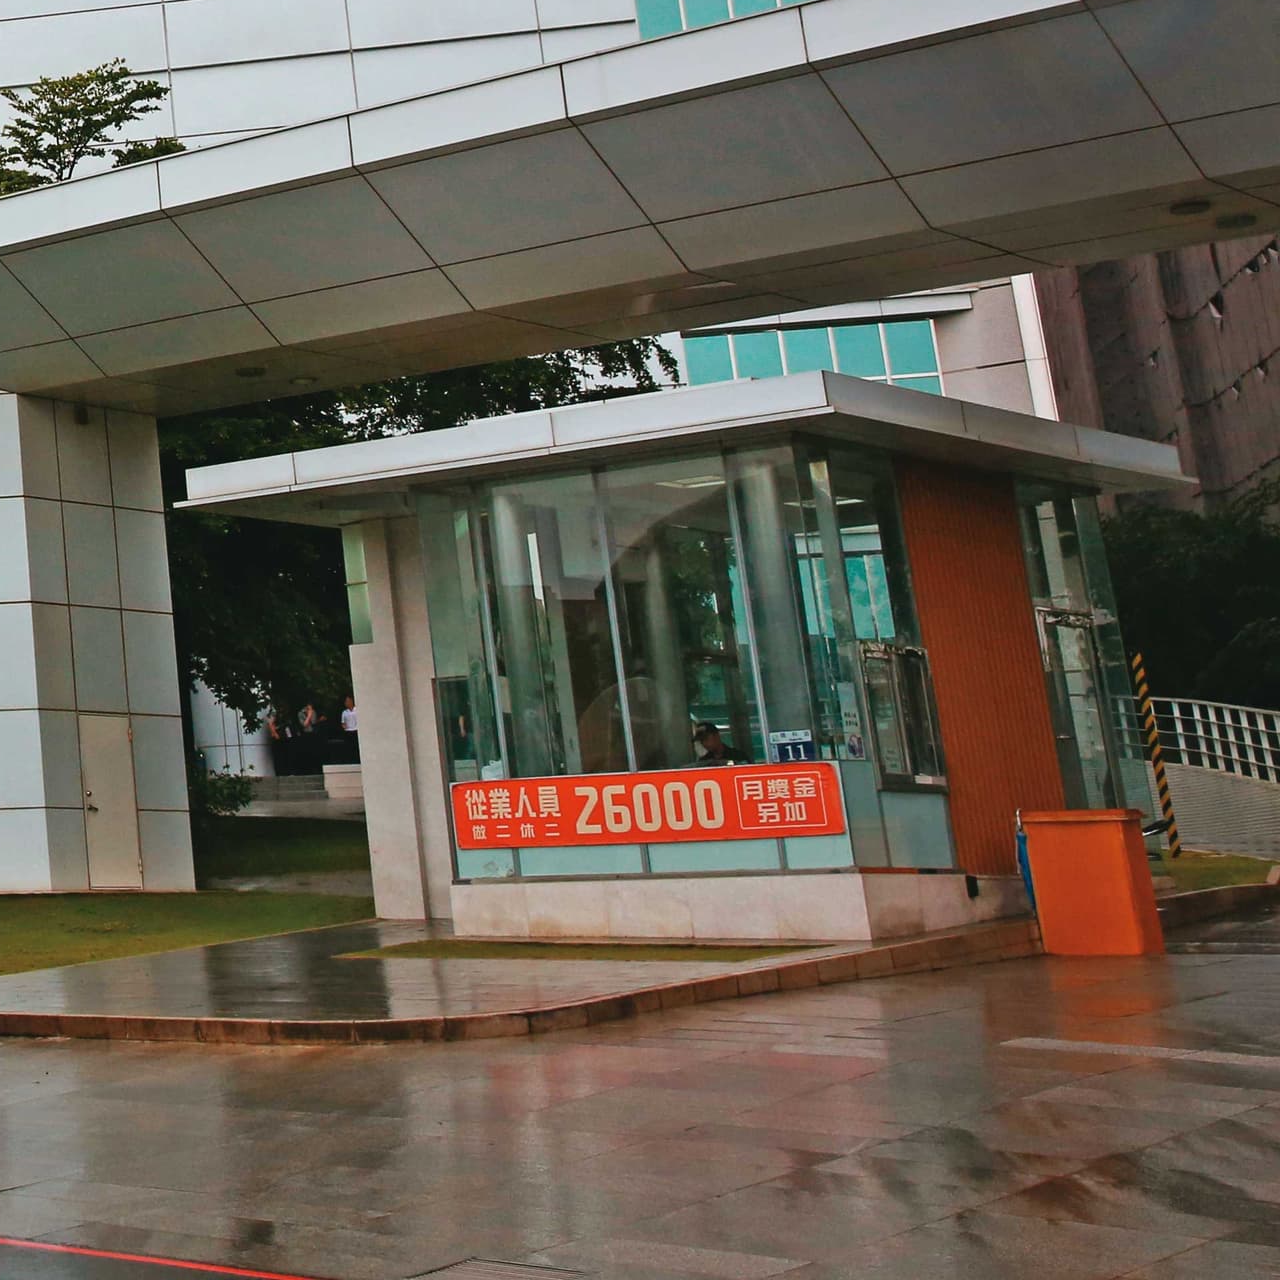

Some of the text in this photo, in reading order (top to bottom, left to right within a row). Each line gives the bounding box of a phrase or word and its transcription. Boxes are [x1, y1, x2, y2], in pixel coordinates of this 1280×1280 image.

[785, 743, 808, 761] 11
[742, 777, 817, 800] 月獎金
[465, 780, 725, 835] 從業人員 26000
[757, 801, 807, 823] 另加
[472, 823, 560, 840] 做二休二
